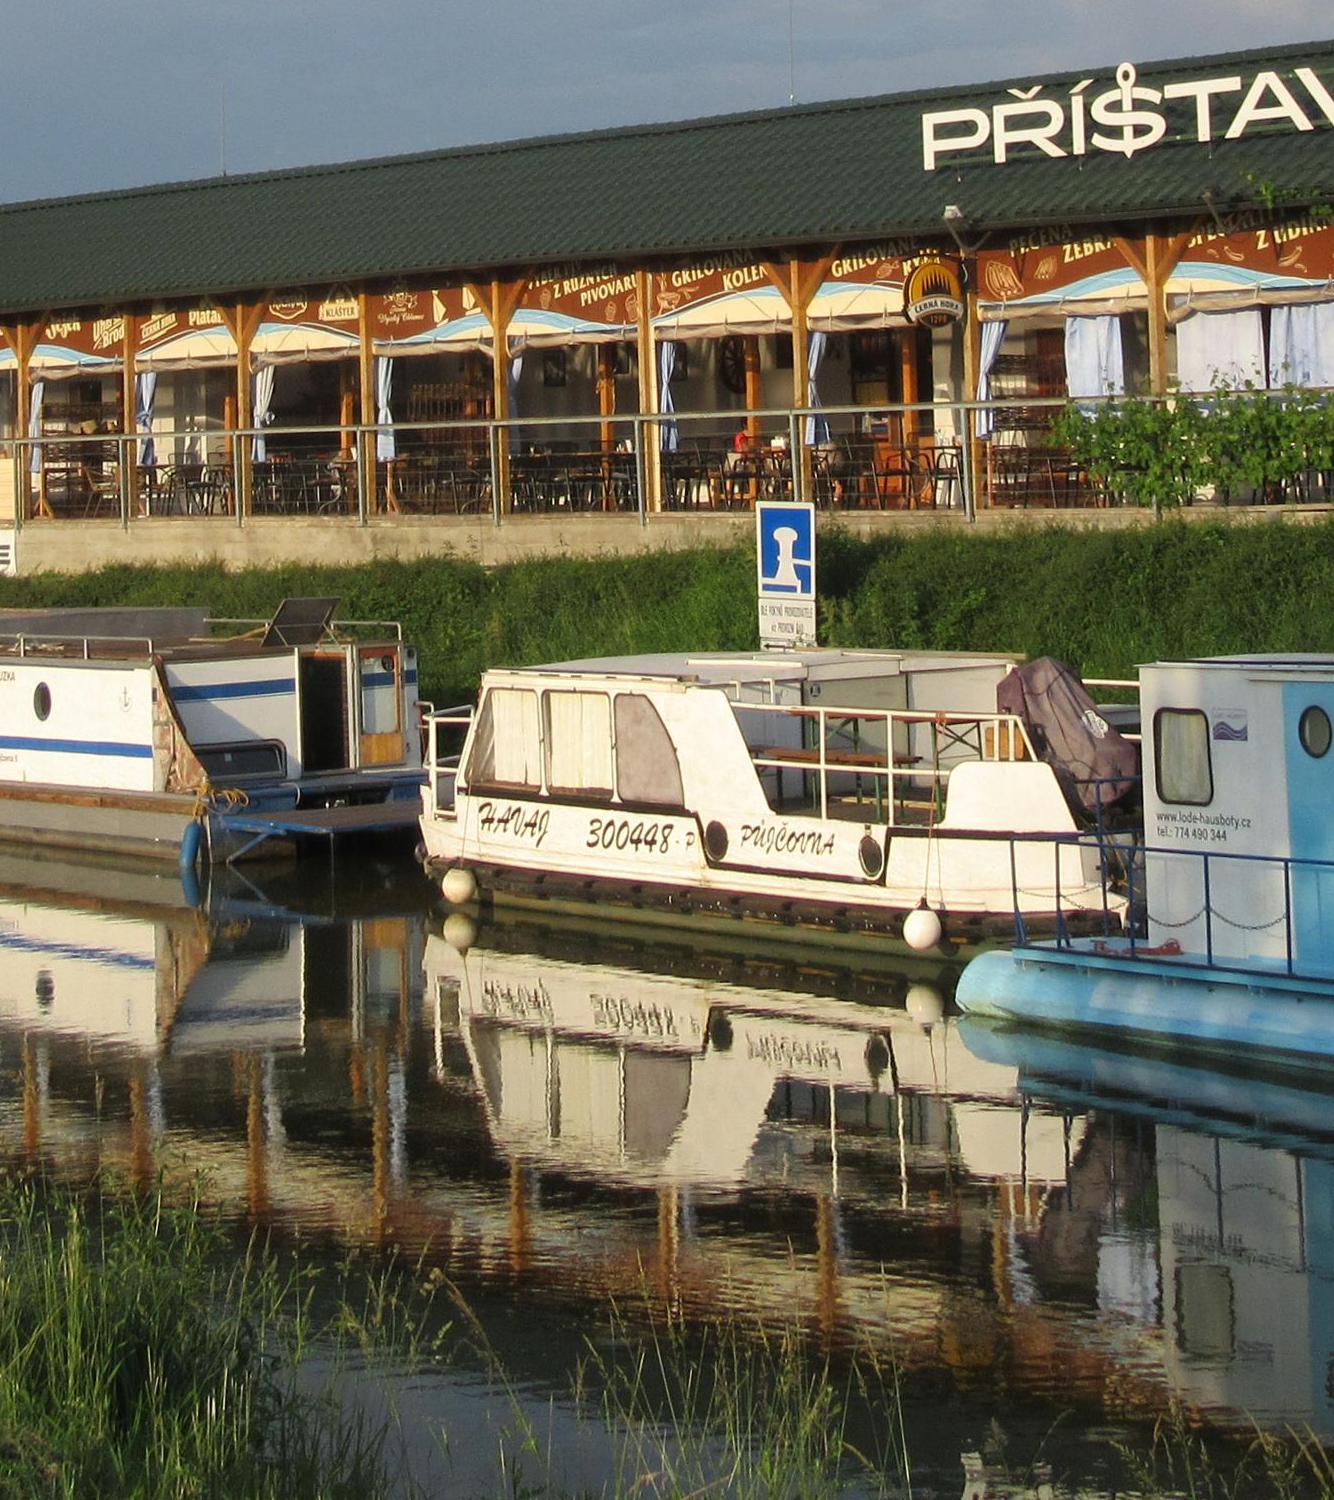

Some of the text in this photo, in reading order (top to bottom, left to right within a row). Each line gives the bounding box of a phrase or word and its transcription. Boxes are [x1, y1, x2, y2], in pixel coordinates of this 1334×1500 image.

[940, 299, 959, 311] HORA
[1174, 826, 1190, 839] 774
[1191, 828, 1208, 841] 490
[1210, 829, 1227, 842] 344
